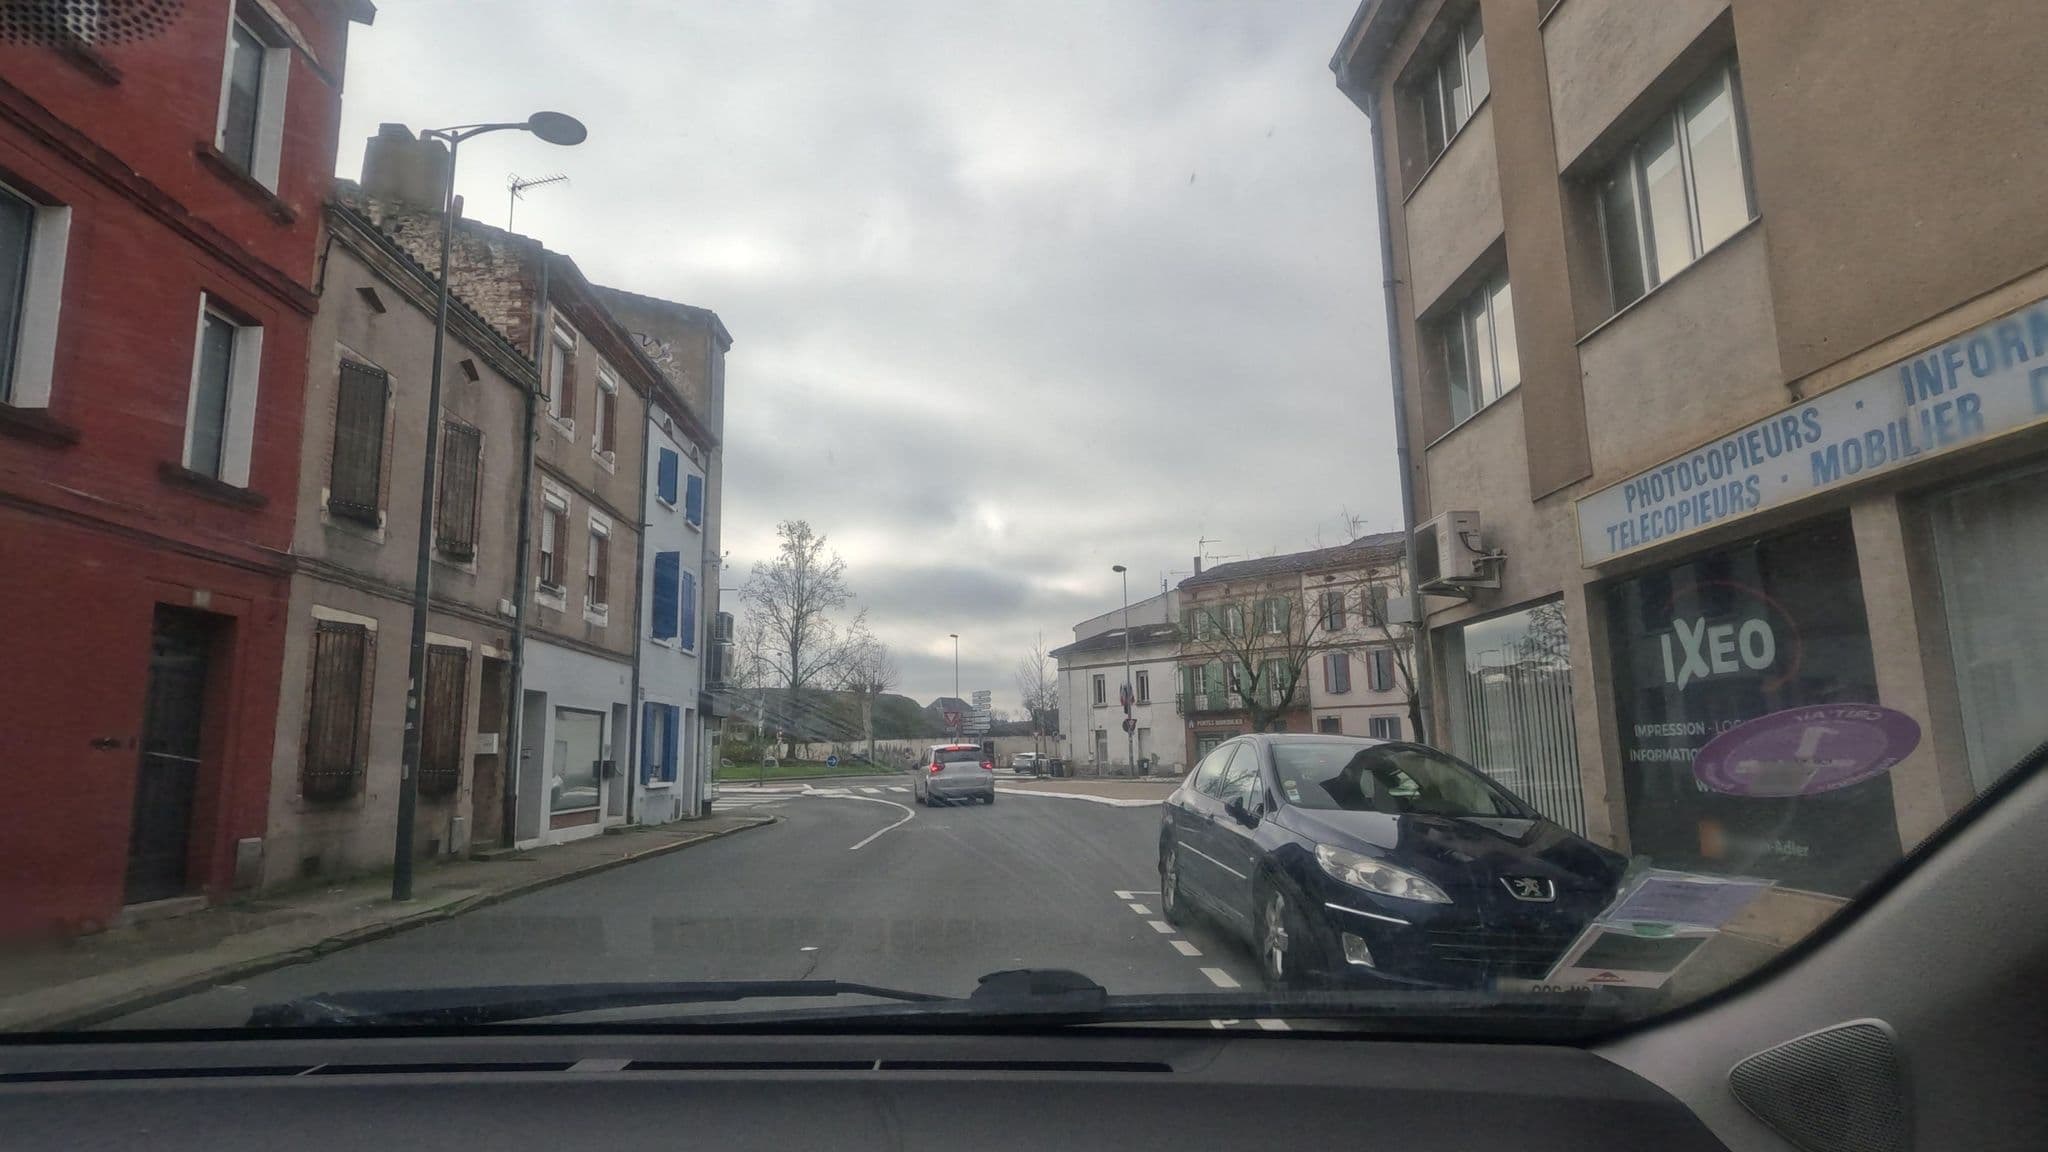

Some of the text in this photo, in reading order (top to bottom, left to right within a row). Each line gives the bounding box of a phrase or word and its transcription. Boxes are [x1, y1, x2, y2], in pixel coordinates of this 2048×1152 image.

[1606, 474, 1761, 553] TELECOPIEURS
[1810, 393, 1984, 487] MOBILIER
[1624, 407, 1822, 513] PHOTOCOPIEURS
[1660, 617, 1776, 691] IXEO
[1634, 721, 1705, 737] IMPRESSION
